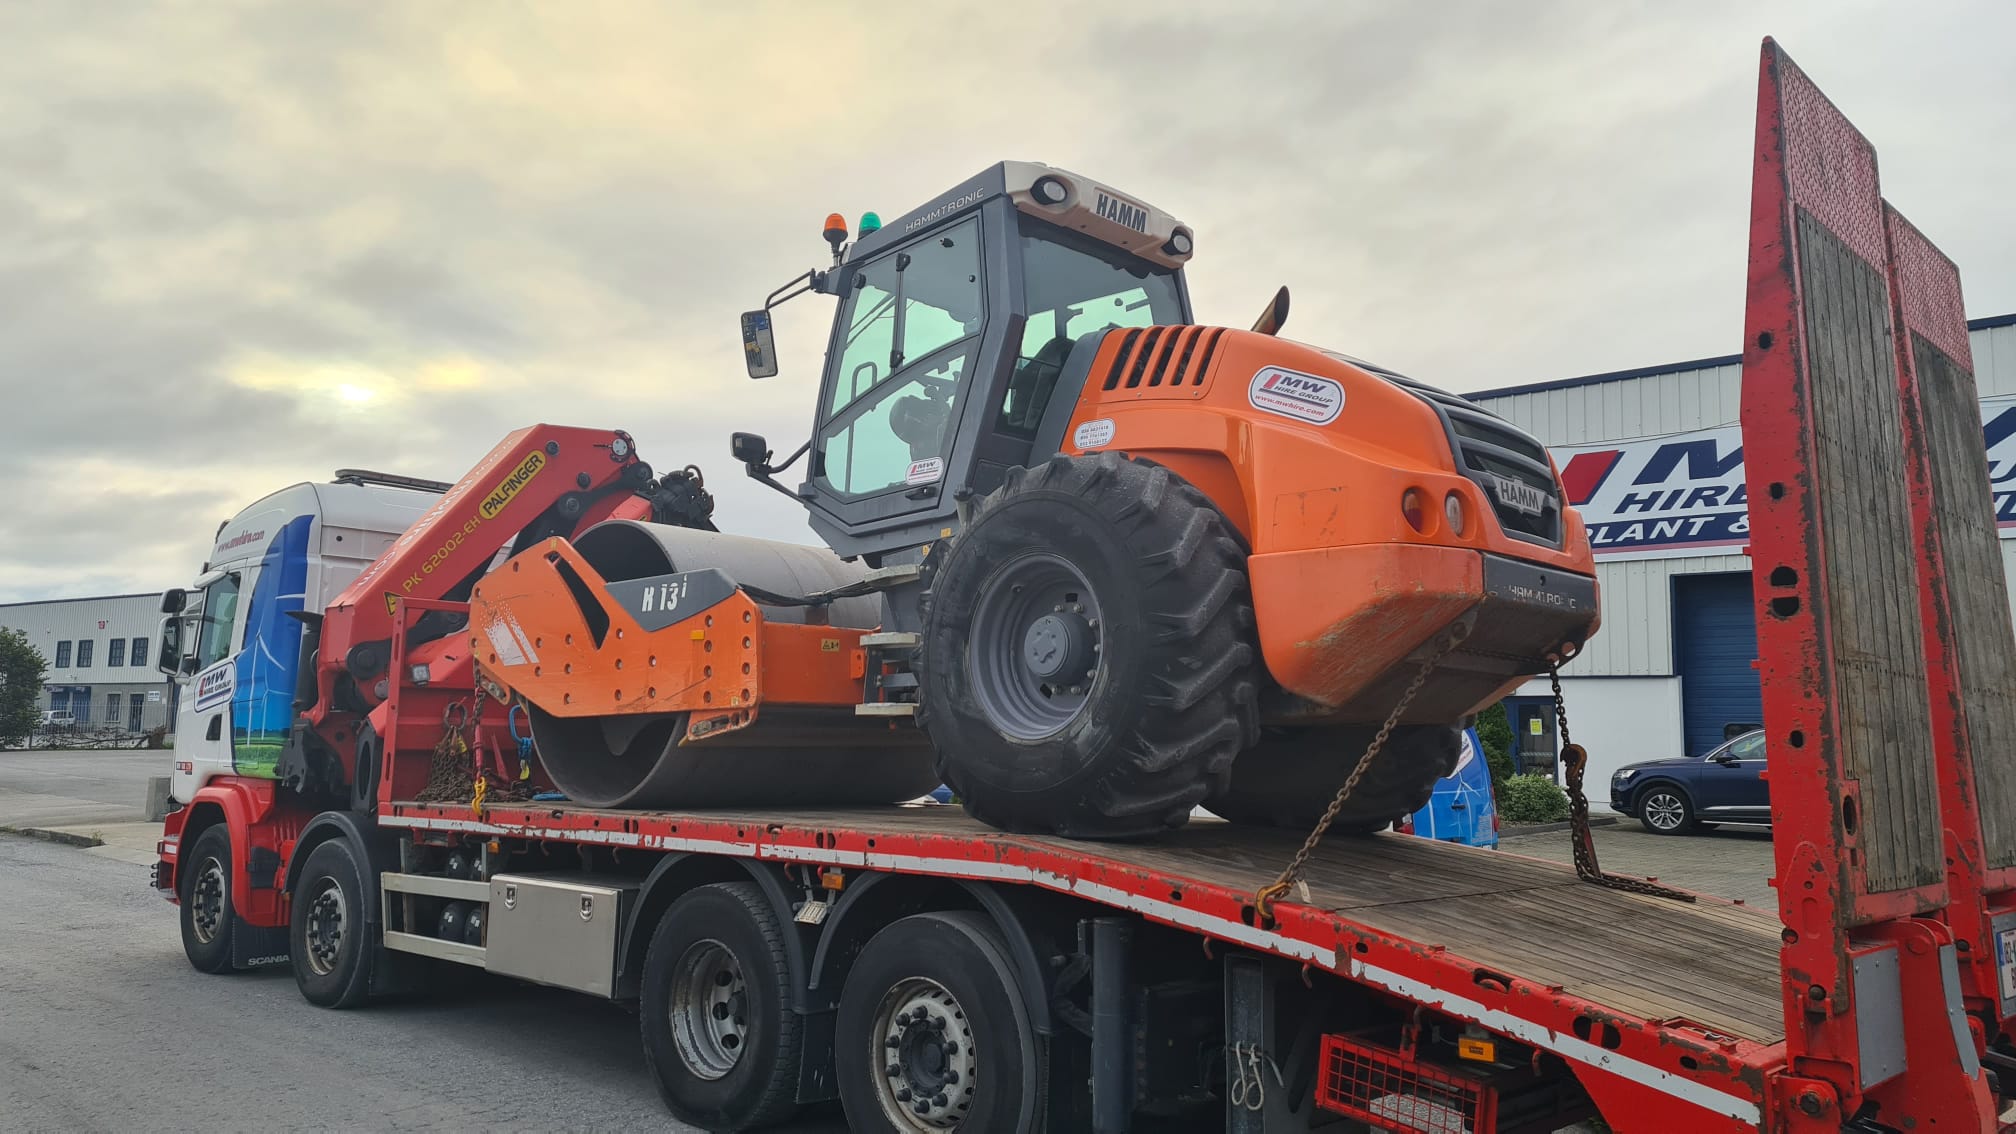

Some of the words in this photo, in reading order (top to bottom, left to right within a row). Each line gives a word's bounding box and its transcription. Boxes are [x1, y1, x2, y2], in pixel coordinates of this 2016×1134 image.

[905, 187, 984, 232] HAMMTRONIC
[1096, 193, 1147, 233] HAMM
[1255, 394, 1325, 417] www.mwhire.com
[1273, 386, 1298, 395] HIRE
[1298, 391, 1334, 403] GROUP
[482, 453, 544, 516] PALFINGER
[1500, 480, 1540, 510] HAMM
[402, 573, 423, 593] PK
[422, 515, 481, 575] 62002-EH
[641, 586, 655, 613] H
[248, 954, 290, 966] SCANIA
